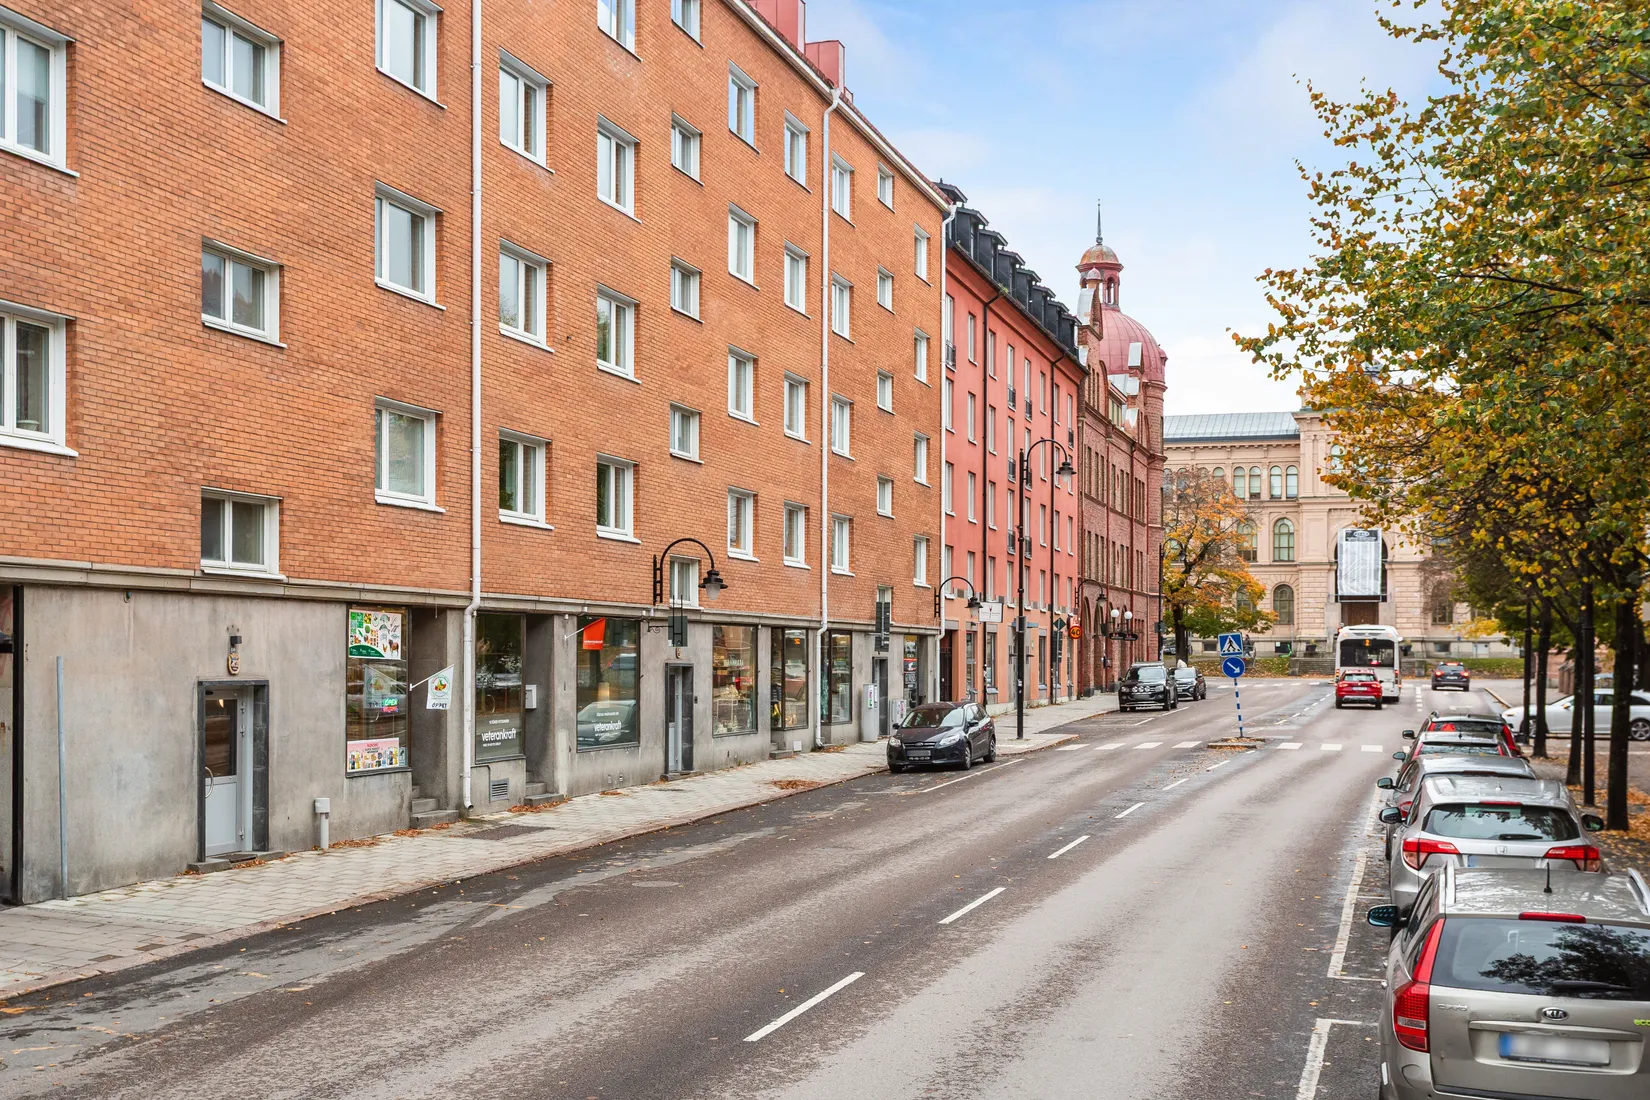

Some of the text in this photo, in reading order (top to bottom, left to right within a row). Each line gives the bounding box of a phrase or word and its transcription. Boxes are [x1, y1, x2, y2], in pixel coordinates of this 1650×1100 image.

[1071, 628, 1081, 636] 40
[593, 720, 622, 731] veterankraft
[481, 728, 517, 741] veterankraft
[1546, 1010, 1564, 1018] KIA
